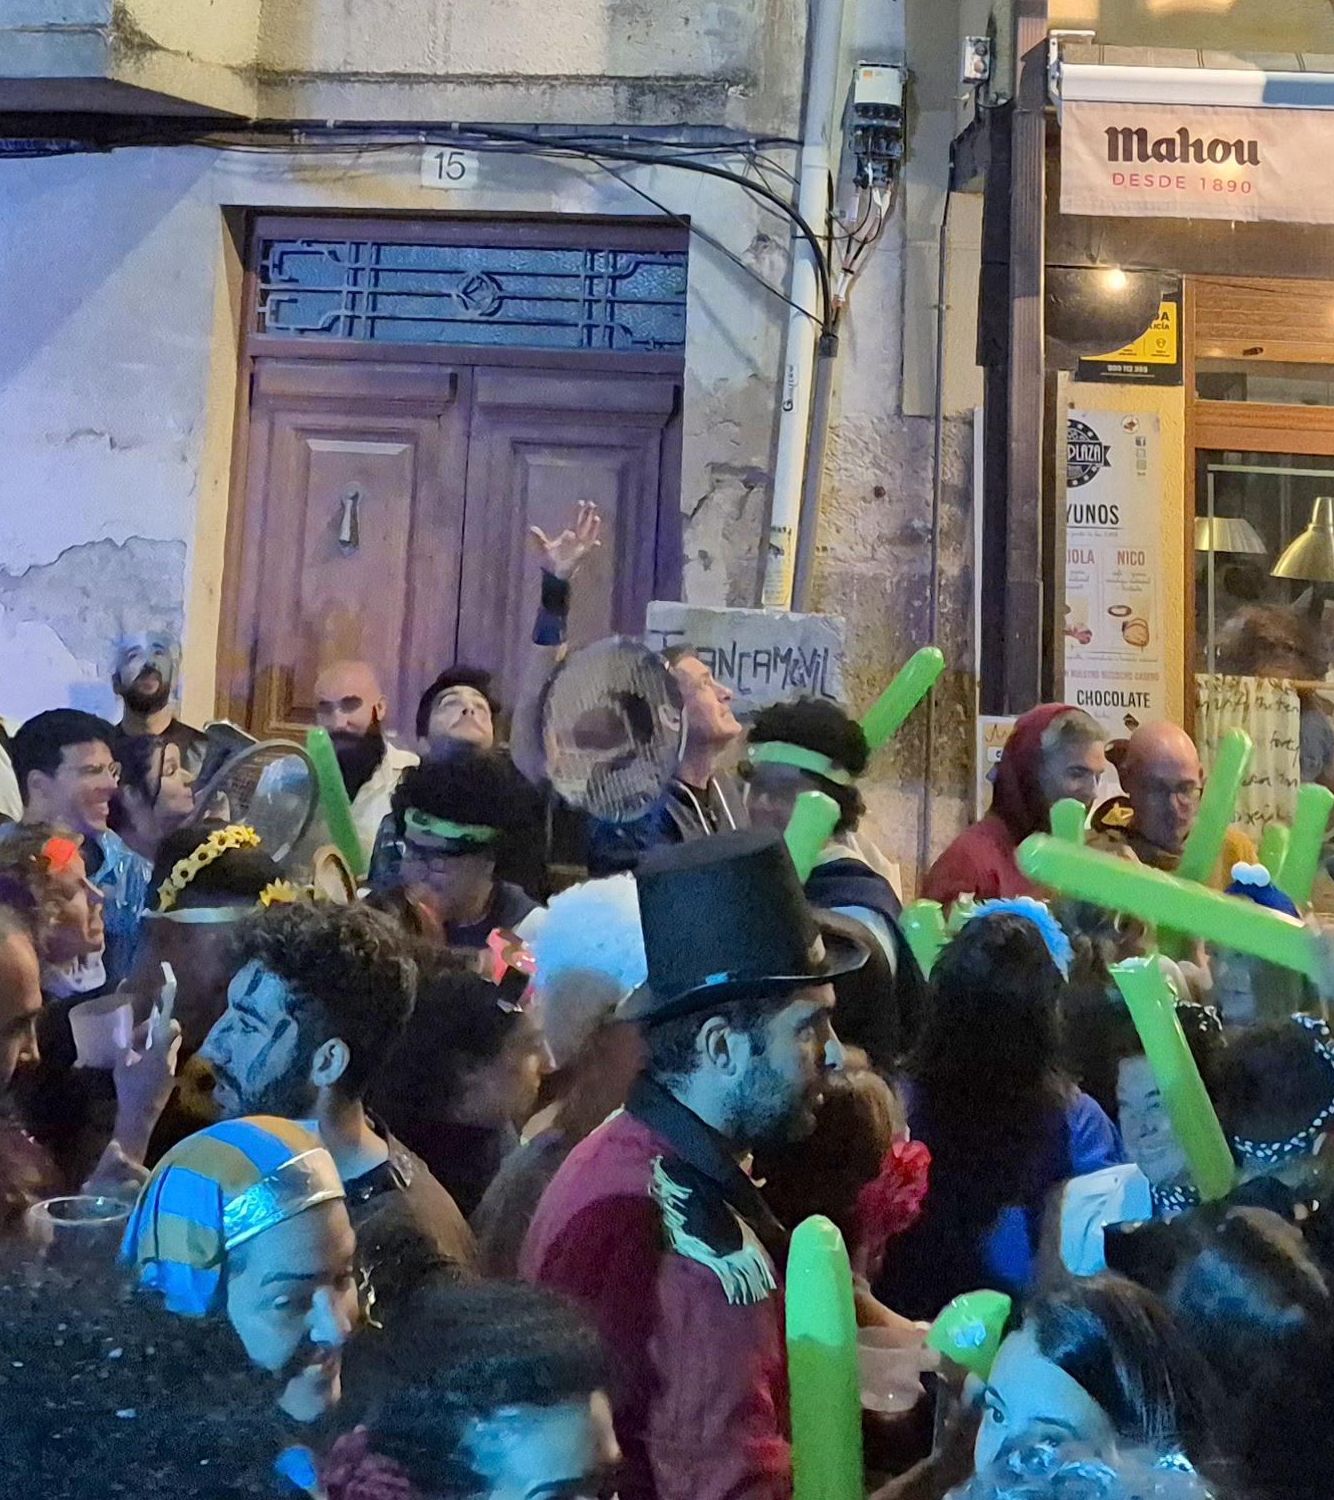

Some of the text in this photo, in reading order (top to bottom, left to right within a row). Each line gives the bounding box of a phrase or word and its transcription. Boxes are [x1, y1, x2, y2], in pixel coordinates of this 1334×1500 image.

[1104, 126, 1261, 166] Mahou
[434, 151, 466, 181] 15
[1112, 172, 1252, 194] DESDE 1890
[1068, 444, 1101, 462] PLAZA
[1067, 503, 1120, 525] YUNOS
[1117, 550, 1146, 567] NICO
[1077, 689, 1151, 708] CHOCOLATE
